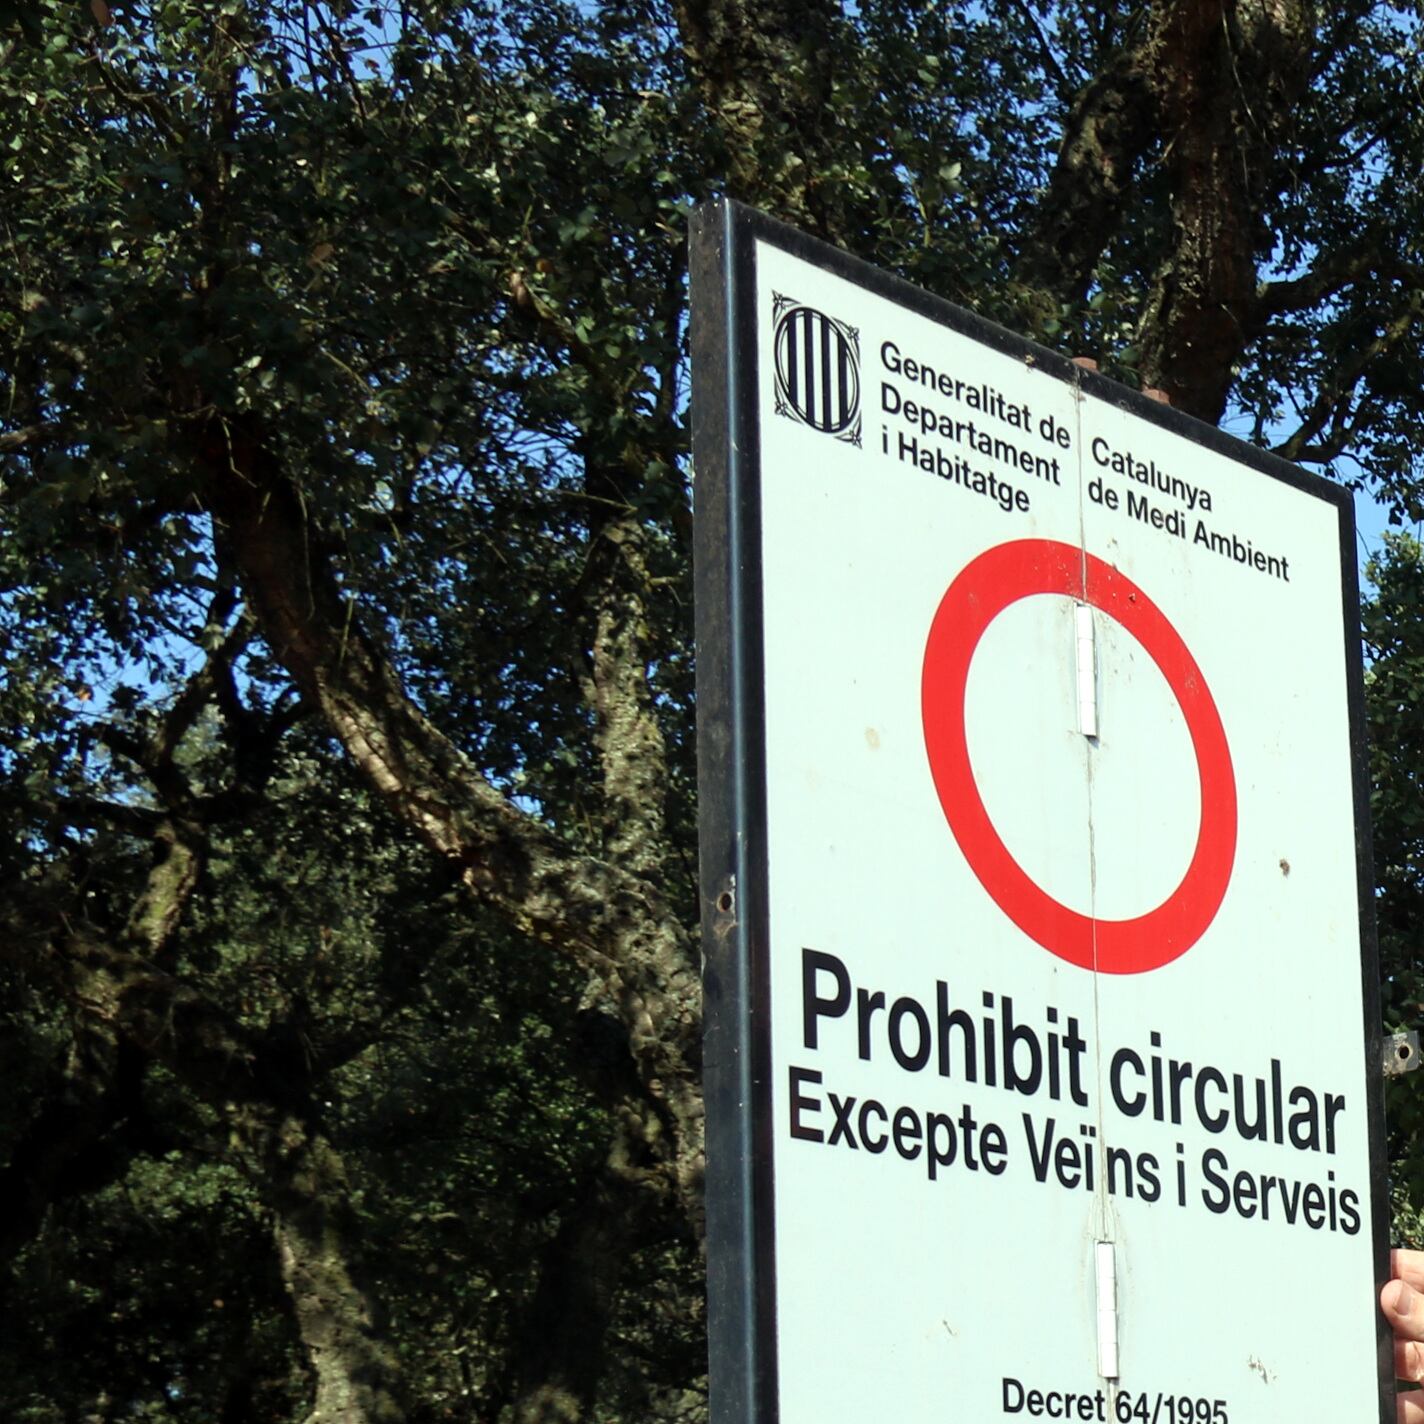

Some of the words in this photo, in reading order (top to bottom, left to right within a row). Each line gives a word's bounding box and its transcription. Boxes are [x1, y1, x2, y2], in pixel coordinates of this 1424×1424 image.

[880, 341, 1032, 433] Generalitat
[1039, 415, 1071, 449] de
[1091, 437, 1212, 512] Catalunya
[881, 381, 1061, 486] Departament
[1088, 477, 1119, 512] de
[1127, 489, 1186, 539] Medi
[1193, 520, 1290, 582] Ambient
[882, 425, 888, 455] i
[898, 431, 1030, 513] Habitatge
[802, 947, 1089, 1108] Prohibit
[1109, 1030, 1346, 1155] circular
[788, 1065, 1008, 1181] Excepte
[1021, 1112, 1161, 1203] Veïns
[1176, 1142, 1187, 1207] i
[1201, 1147, 1361, 1236] Serveis
[1002, 1377, 1106, 1422] Decret
